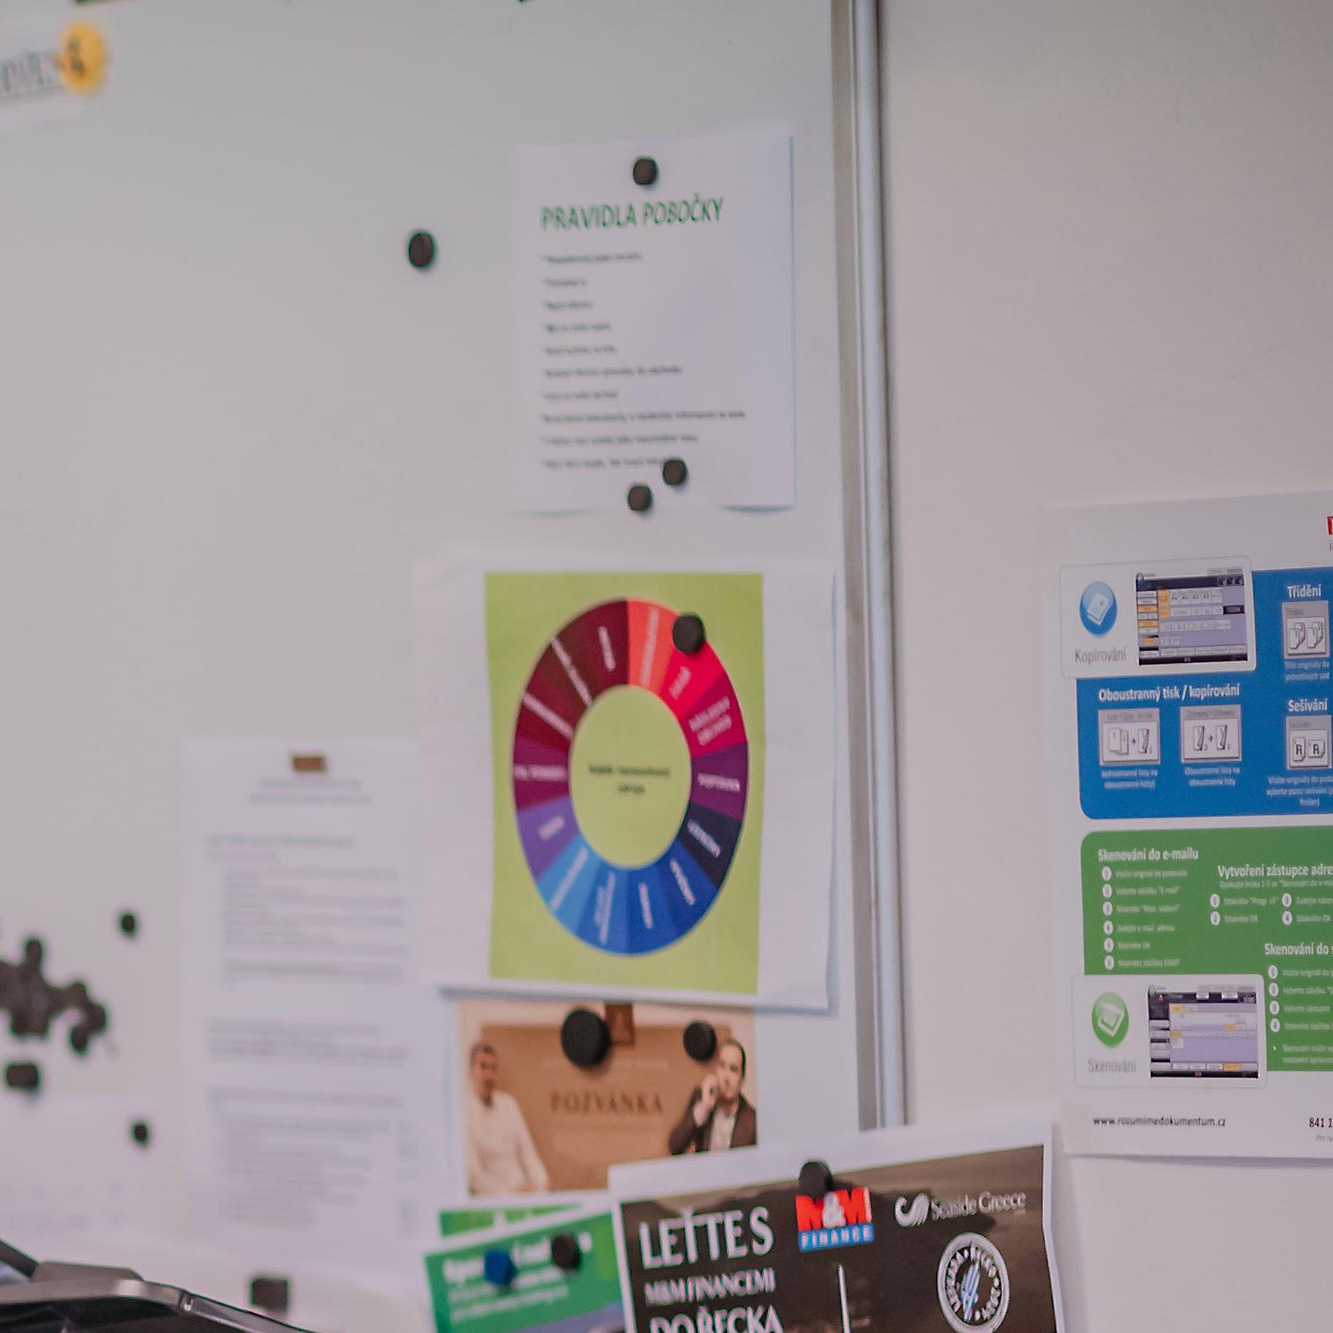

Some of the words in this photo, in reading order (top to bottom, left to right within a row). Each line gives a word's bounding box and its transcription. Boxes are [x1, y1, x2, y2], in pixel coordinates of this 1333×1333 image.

[541, 203, 637, 231] PRAVIDLA
[643, 191, 724, 227] POBOČKY
[1075, 647, 1127, 666] Kopírování
[1098, 687, 1161, 703] Oboustranný
[1162, 685, 1180, 699] tisk
[1189, 683, 1240, 700] kopírování
[1288, 698, 1328, 713] Sešívání
[1148, 848, 1161, 861] do
[1218, 864, 1265, 880] Vytvoření
[1267, 864, 1309, 879] zástupce
[1264, 942, 1314, 956] Skenování
[1316, 942, 1329, 955] do
[1309, 1116, 1324, 1128] 841
[795, 1187, 873, 1232] M&M
[800, 1225, 871, 1249] FINANCE
